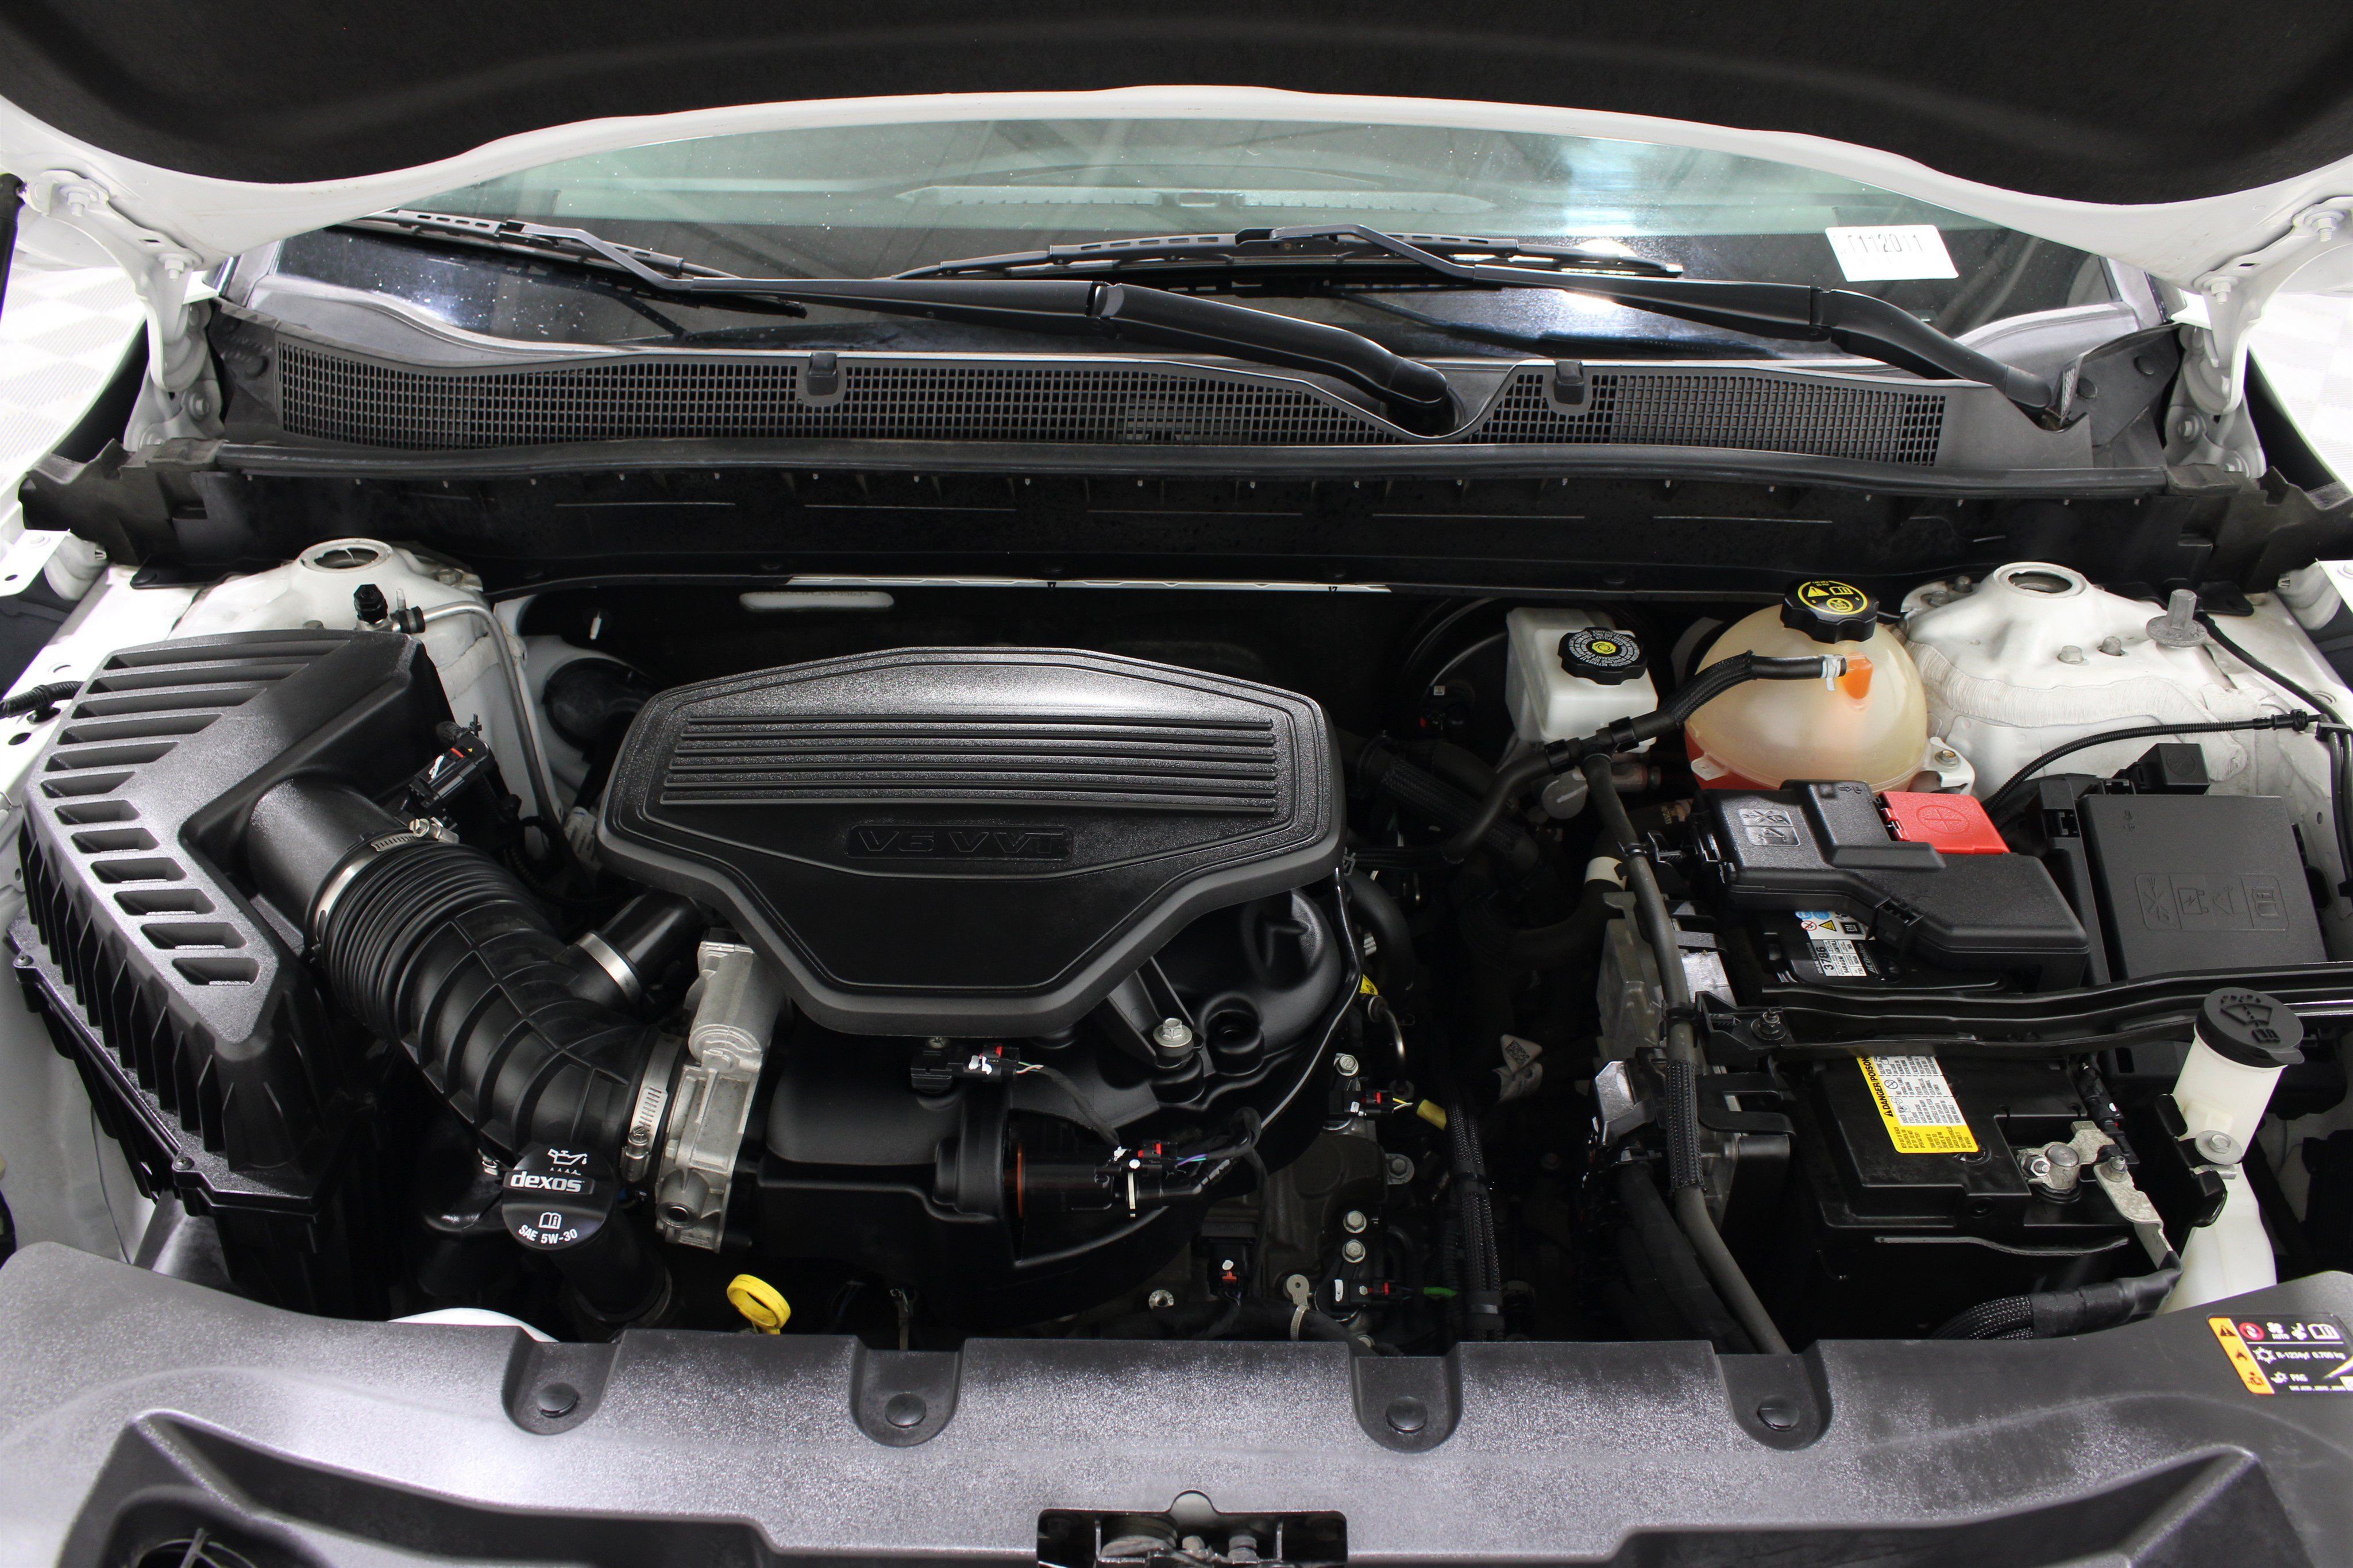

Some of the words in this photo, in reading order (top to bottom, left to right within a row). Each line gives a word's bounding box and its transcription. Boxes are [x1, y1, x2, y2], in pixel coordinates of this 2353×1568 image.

[858, 831, 935, 851] V6
[948, 831, 1064, 853] VVT
[1815, 946, 1834, 971] 3786
[510, 1171, 582, 1192] dexos
[518, 1224, 538, 1242] SAE
[541, 1228, 578, 1244] 5W-30
